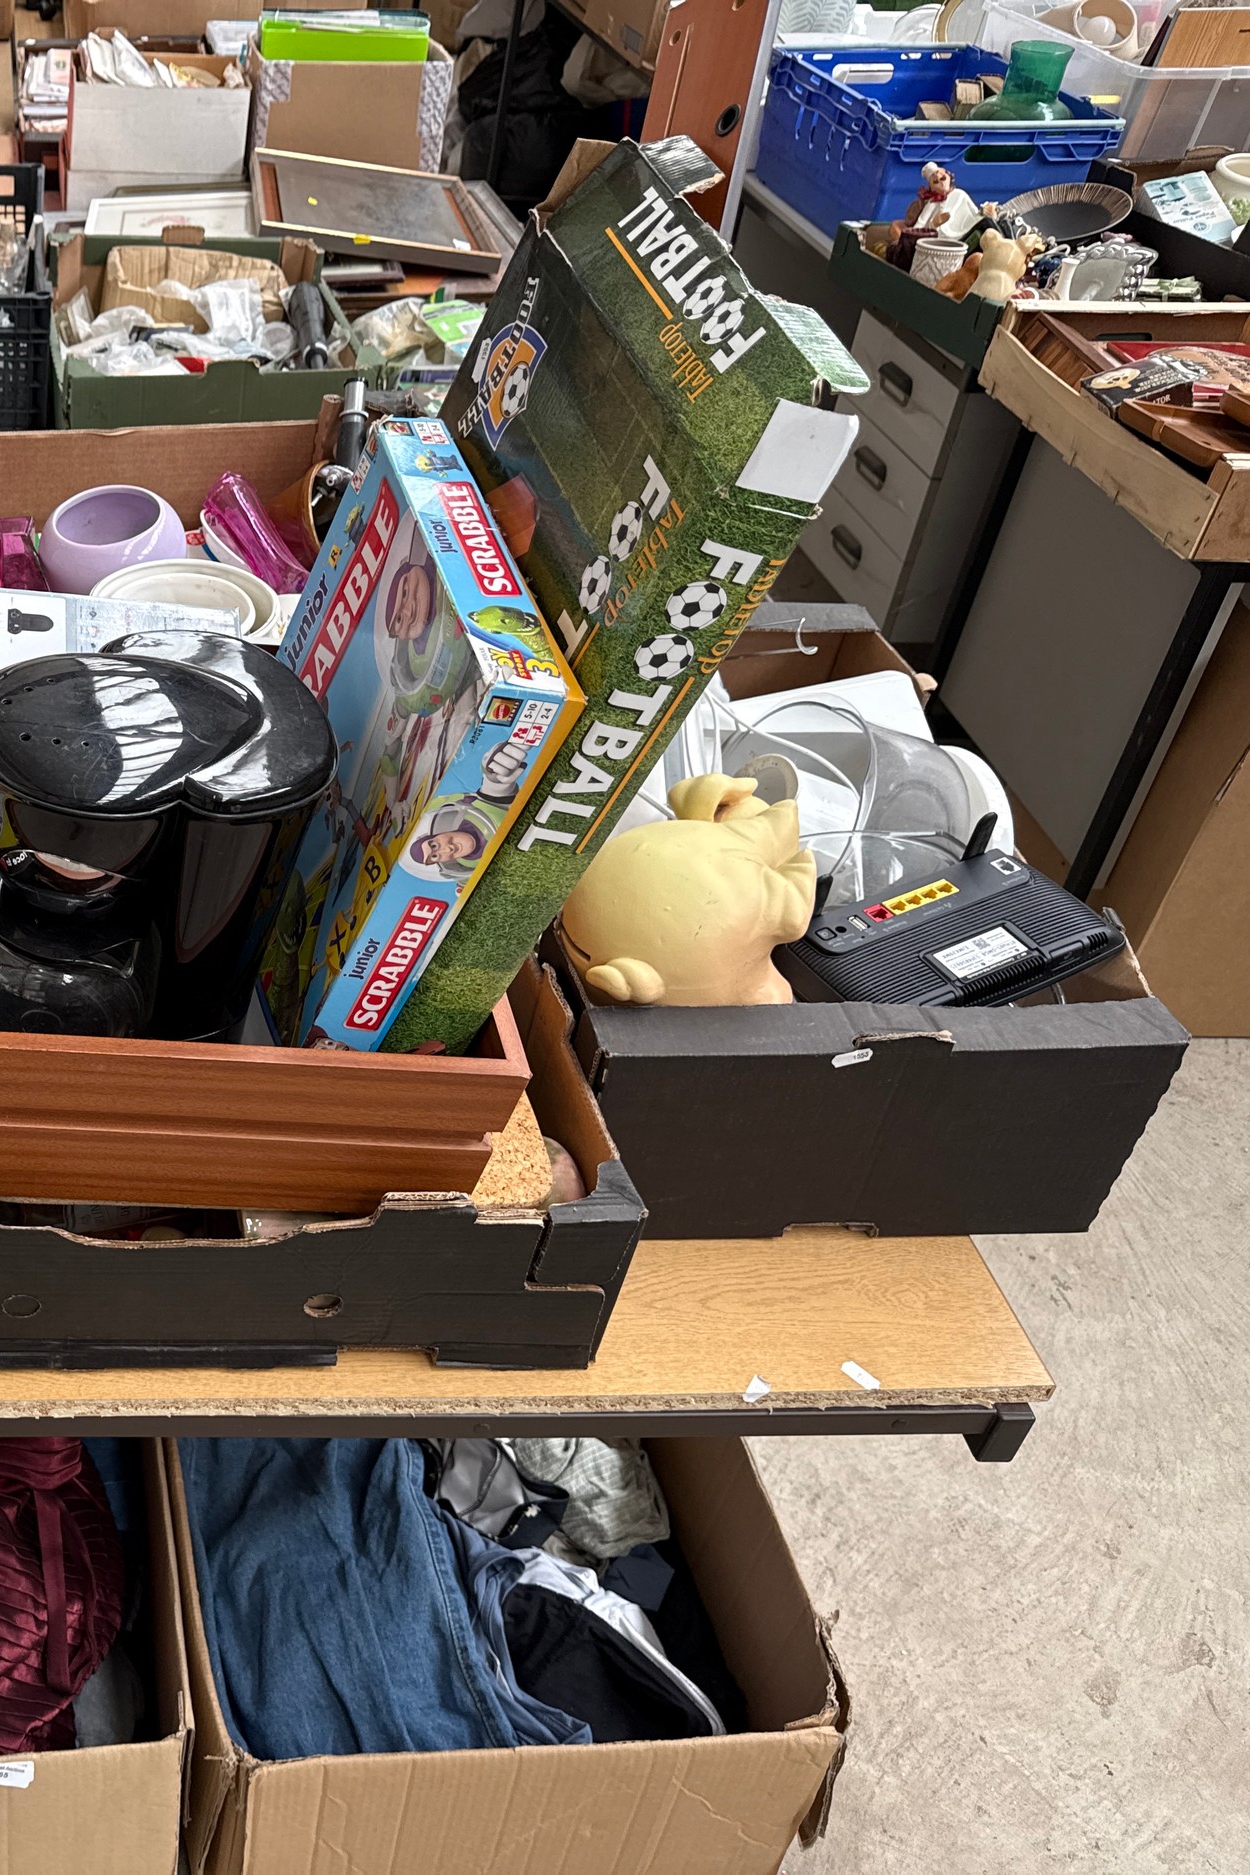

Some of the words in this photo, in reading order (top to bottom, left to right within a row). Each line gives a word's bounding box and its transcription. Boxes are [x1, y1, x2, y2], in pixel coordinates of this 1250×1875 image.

[617, 186, 767, 374] FOOTBALL
[457, 276, 540, 438] FOOTBALL
[428, 520, 458, 553] junior
[449, 485, 513, 593] SCRABBLE
[283, 572, 328, 671] junior
[512, 652, 528, 678] STORY
[526, 658, 560, 678] 3
[516, 538, 764, 852] FOOTBALL
[524, 704, 538, 720] 5-10
[540, 708, 553, 720] 2-4
[364, 858, 381, 884] B
[329, 922, 346, 948] X
[344, 938, 381, 980] junior
[354, 902, 440, 1026] SCRABBLE
